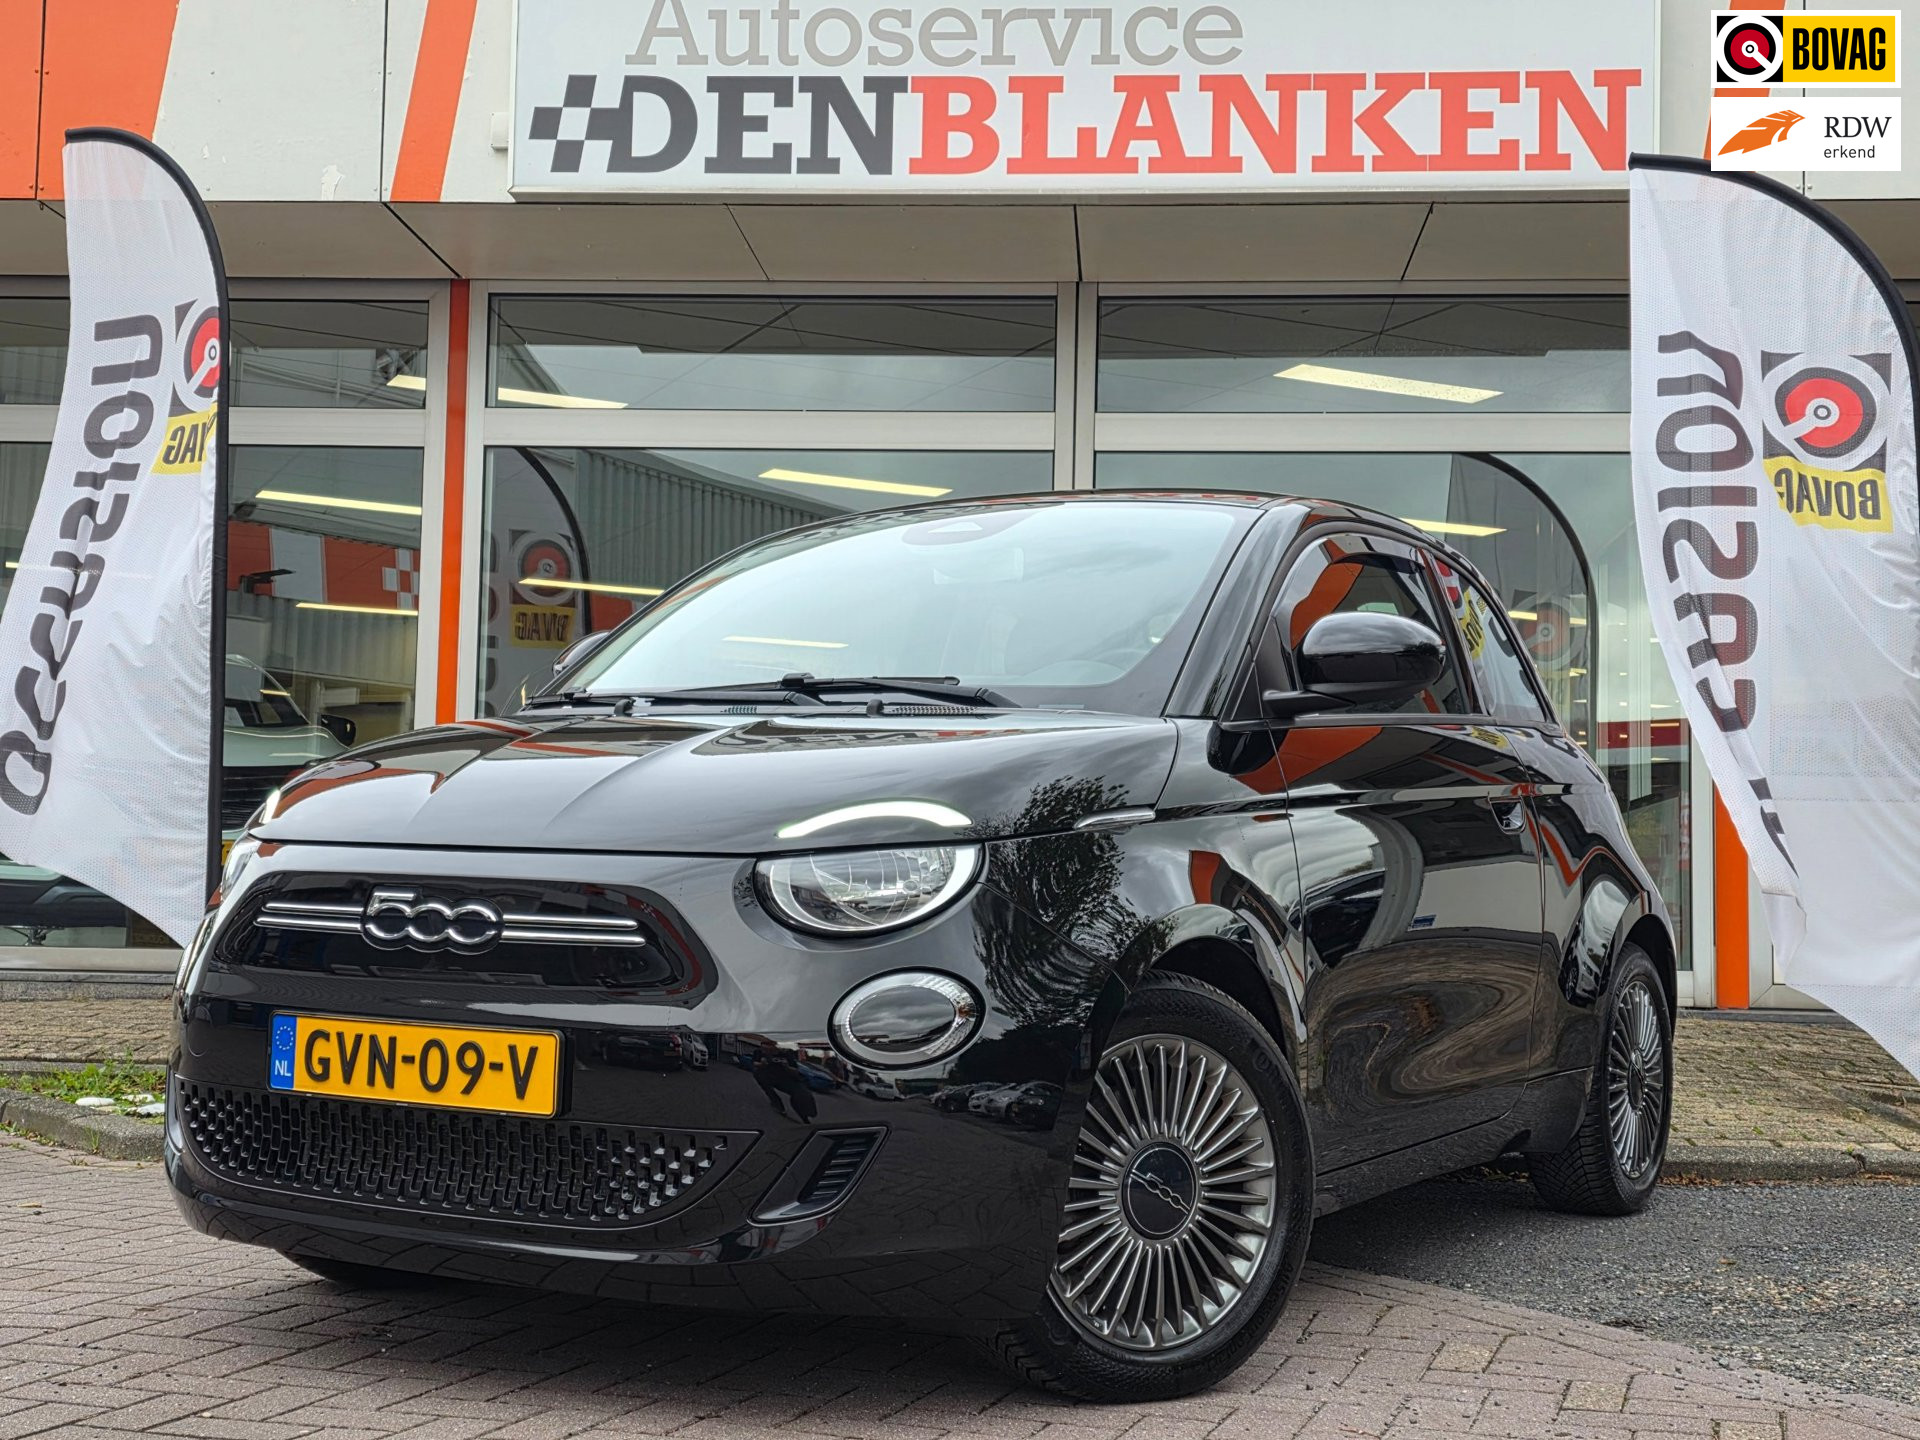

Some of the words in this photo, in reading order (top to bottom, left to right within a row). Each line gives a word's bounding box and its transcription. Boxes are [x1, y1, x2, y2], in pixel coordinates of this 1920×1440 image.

[625, 0, 1243, 67] Autoservice
[365, 889, 499, 946] 500
[275, 1060, 291, 1077] NL
[304, 1029, 539, 1100] GVN-09-V
